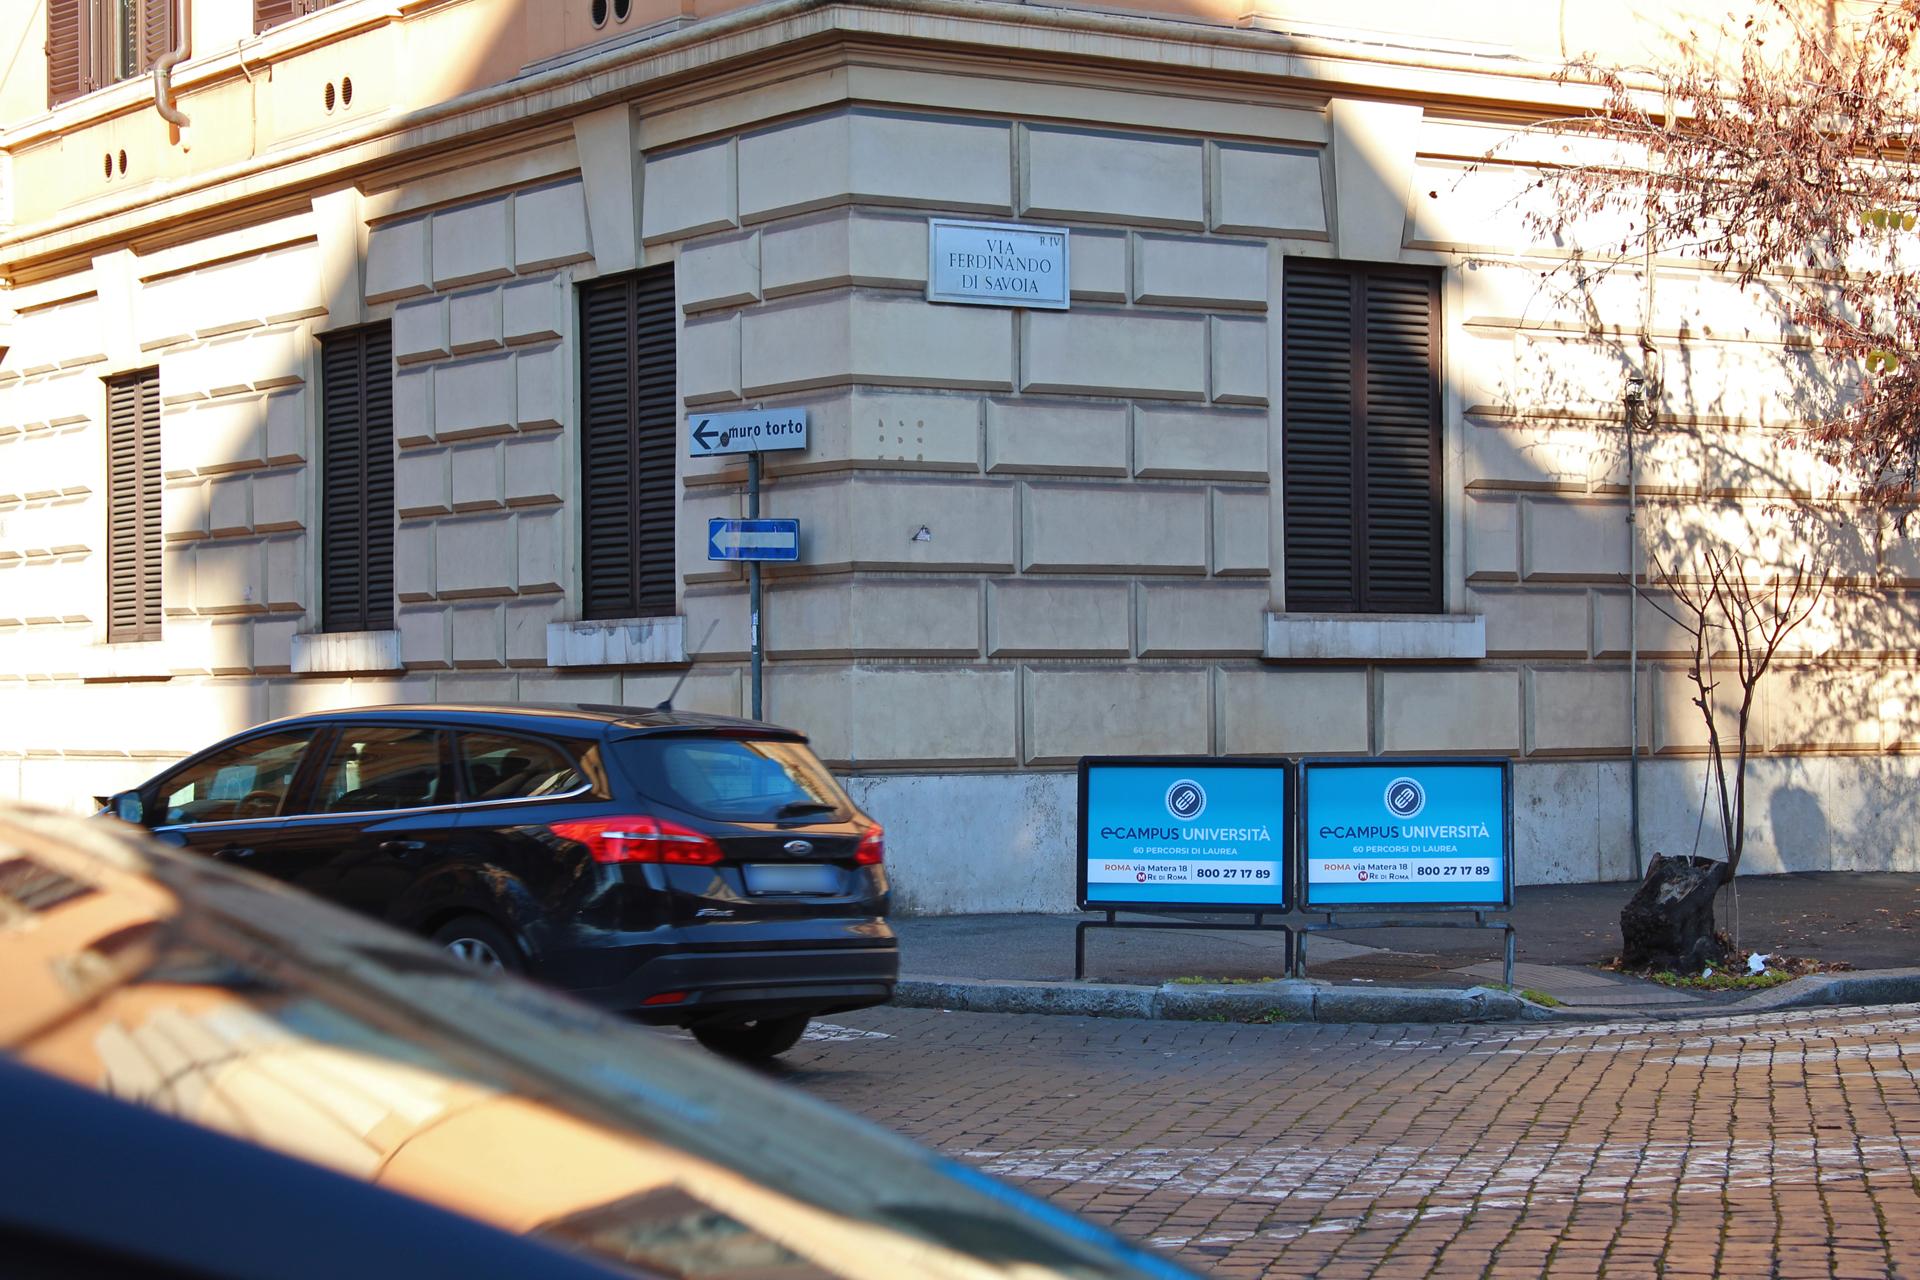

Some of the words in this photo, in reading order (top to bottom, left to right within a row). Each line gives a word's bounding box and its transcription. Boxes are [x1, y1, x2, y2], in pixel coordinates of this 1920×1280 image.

[987, 239, 1015, 255] VIA
[1040, 236, 1046, 247] R
[1050, 237, 1060, 247] IV
[949, 253, 1052, 273] FERDINANDO
[962, 275, 978, 289] DI
[985, 277, 1039, 293] SAVOIA
[728, 426, 760, 439] muro
[766, 419, 802, 435] torto
[1182, 825, 1271, 841] UNIVERSITÀ
[1402, 822, 1490, 838] UNIVERSITÀ
[1133, 846, 1144, 854] 60
[1146, 847, 1189, 855] PERCORSI
[1366, 845, 1409, 853] PERCORSI
[1411, 845, 1421, 853] DI
[1423, 845, 1458, 853] LAUREA
[1133, 864, 1146, 872] via
[1147, 864, 1177, 872] Matera
[1324, 863, 1351, 871] ROMA
[1353, 863, 1366, 871] via
[1368, 863, 1397, 871] Matera
[1417, 866, 1440, 876] 800
[1444, 866, 1457, 876] 27
[1460, 866, 1472, 876] 17
[1475, 866, 1490, 876] 89
[1197, 868, 1220, 878] 800
[1223, 869, 1237, 879] 27
[1240, 869, 1252, 879] 17
[1255, 869, 1271, 879] 89
